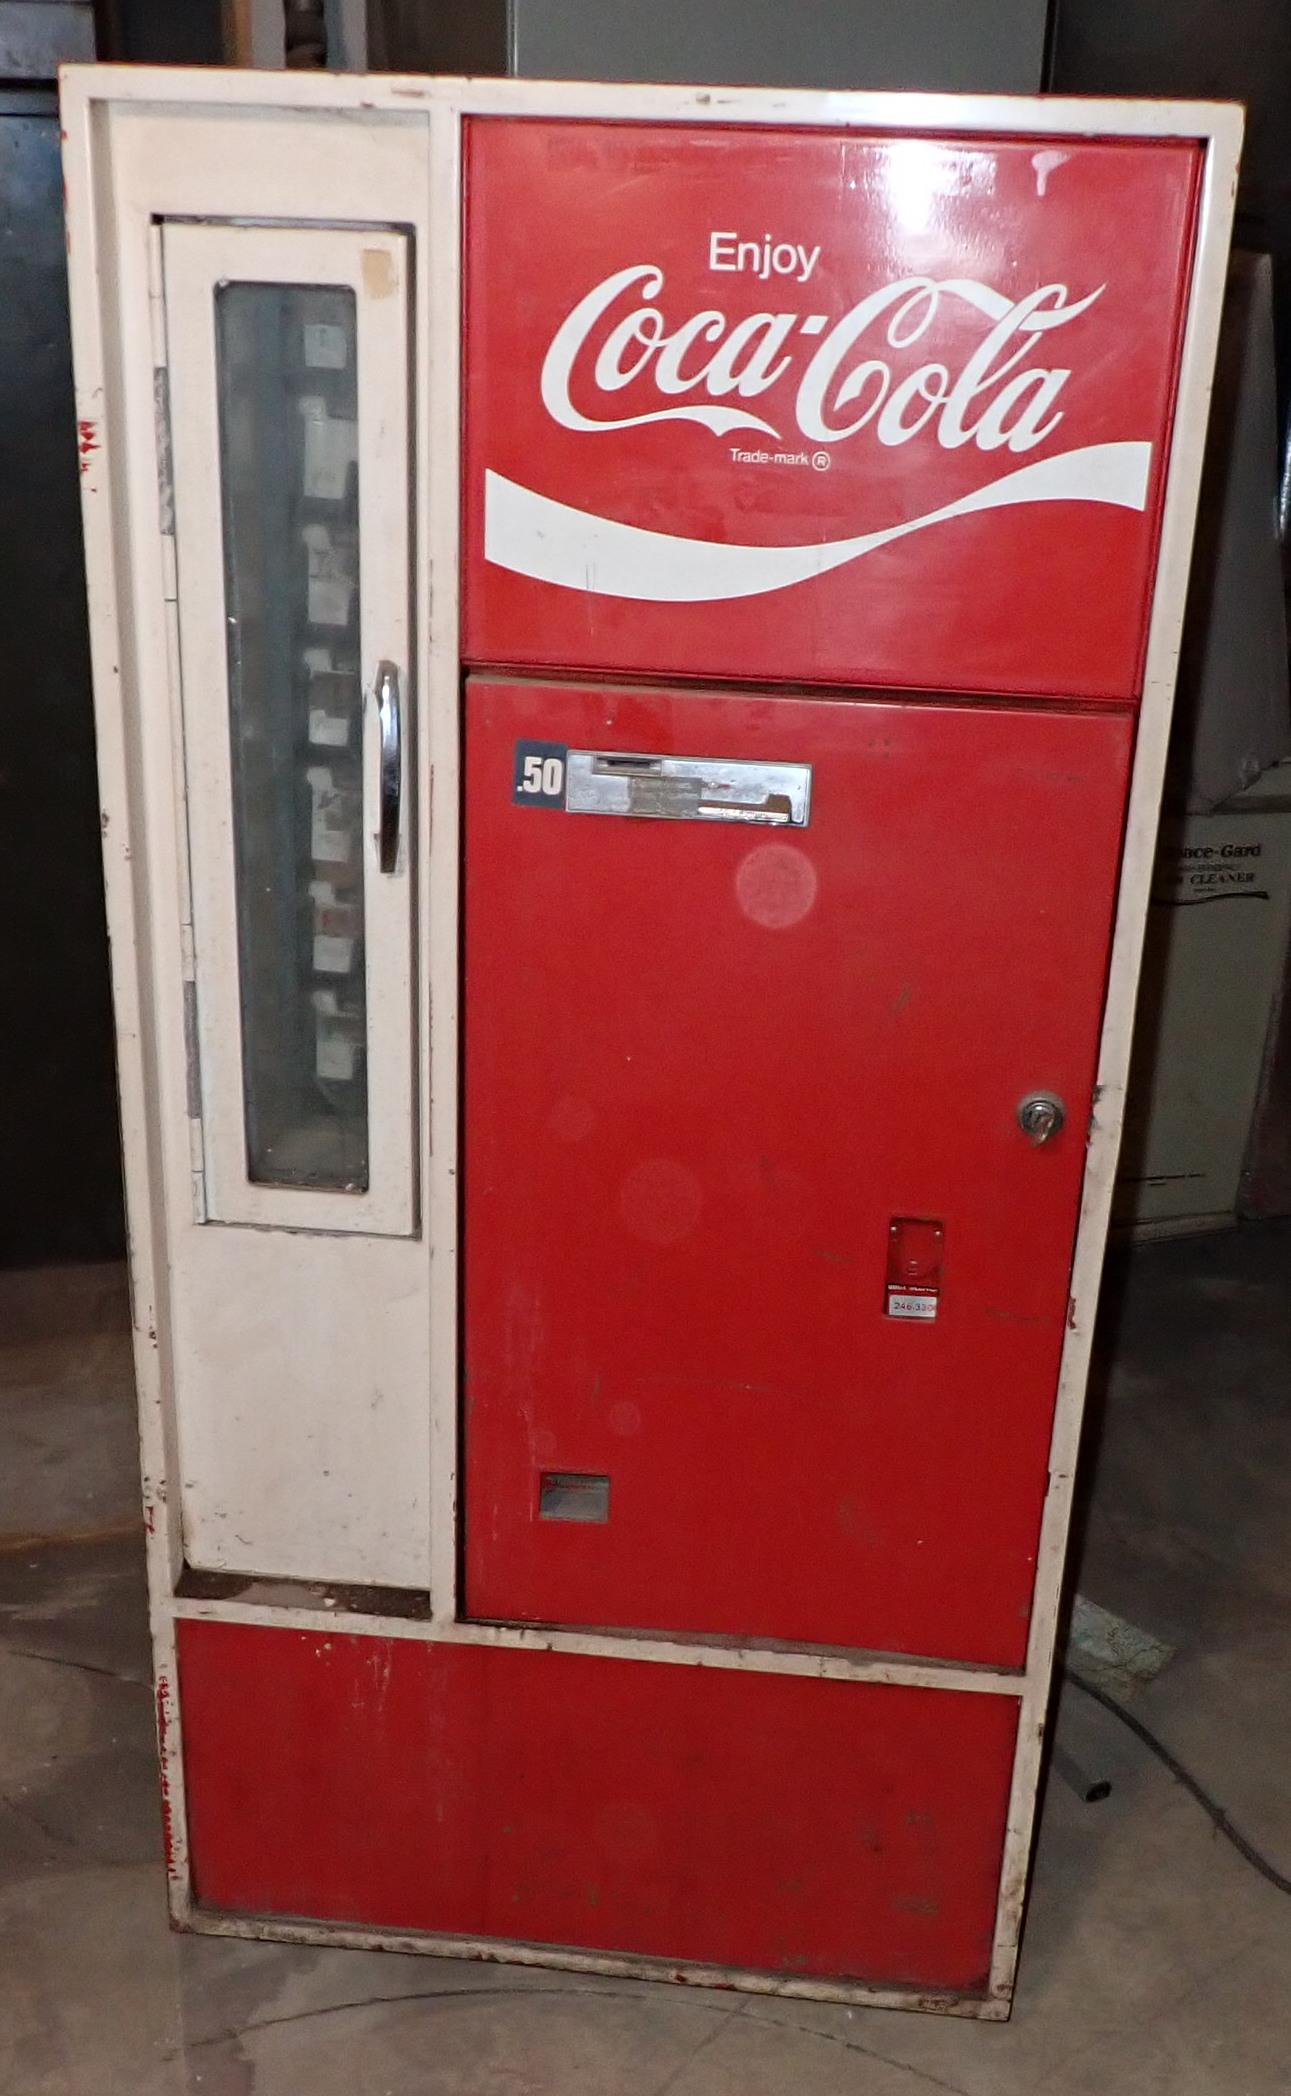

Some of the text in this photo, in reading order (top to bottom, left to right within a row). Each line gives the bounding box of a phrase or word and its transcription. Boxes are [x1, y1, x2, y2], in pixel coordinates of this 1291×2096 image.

[709, 231, 821, 282] Enjoy
[540, 264, 1107, 453] Coca-Cola
[729, 448, 809, 465] Trade-mark
[516, 755, 563, 796] .50
